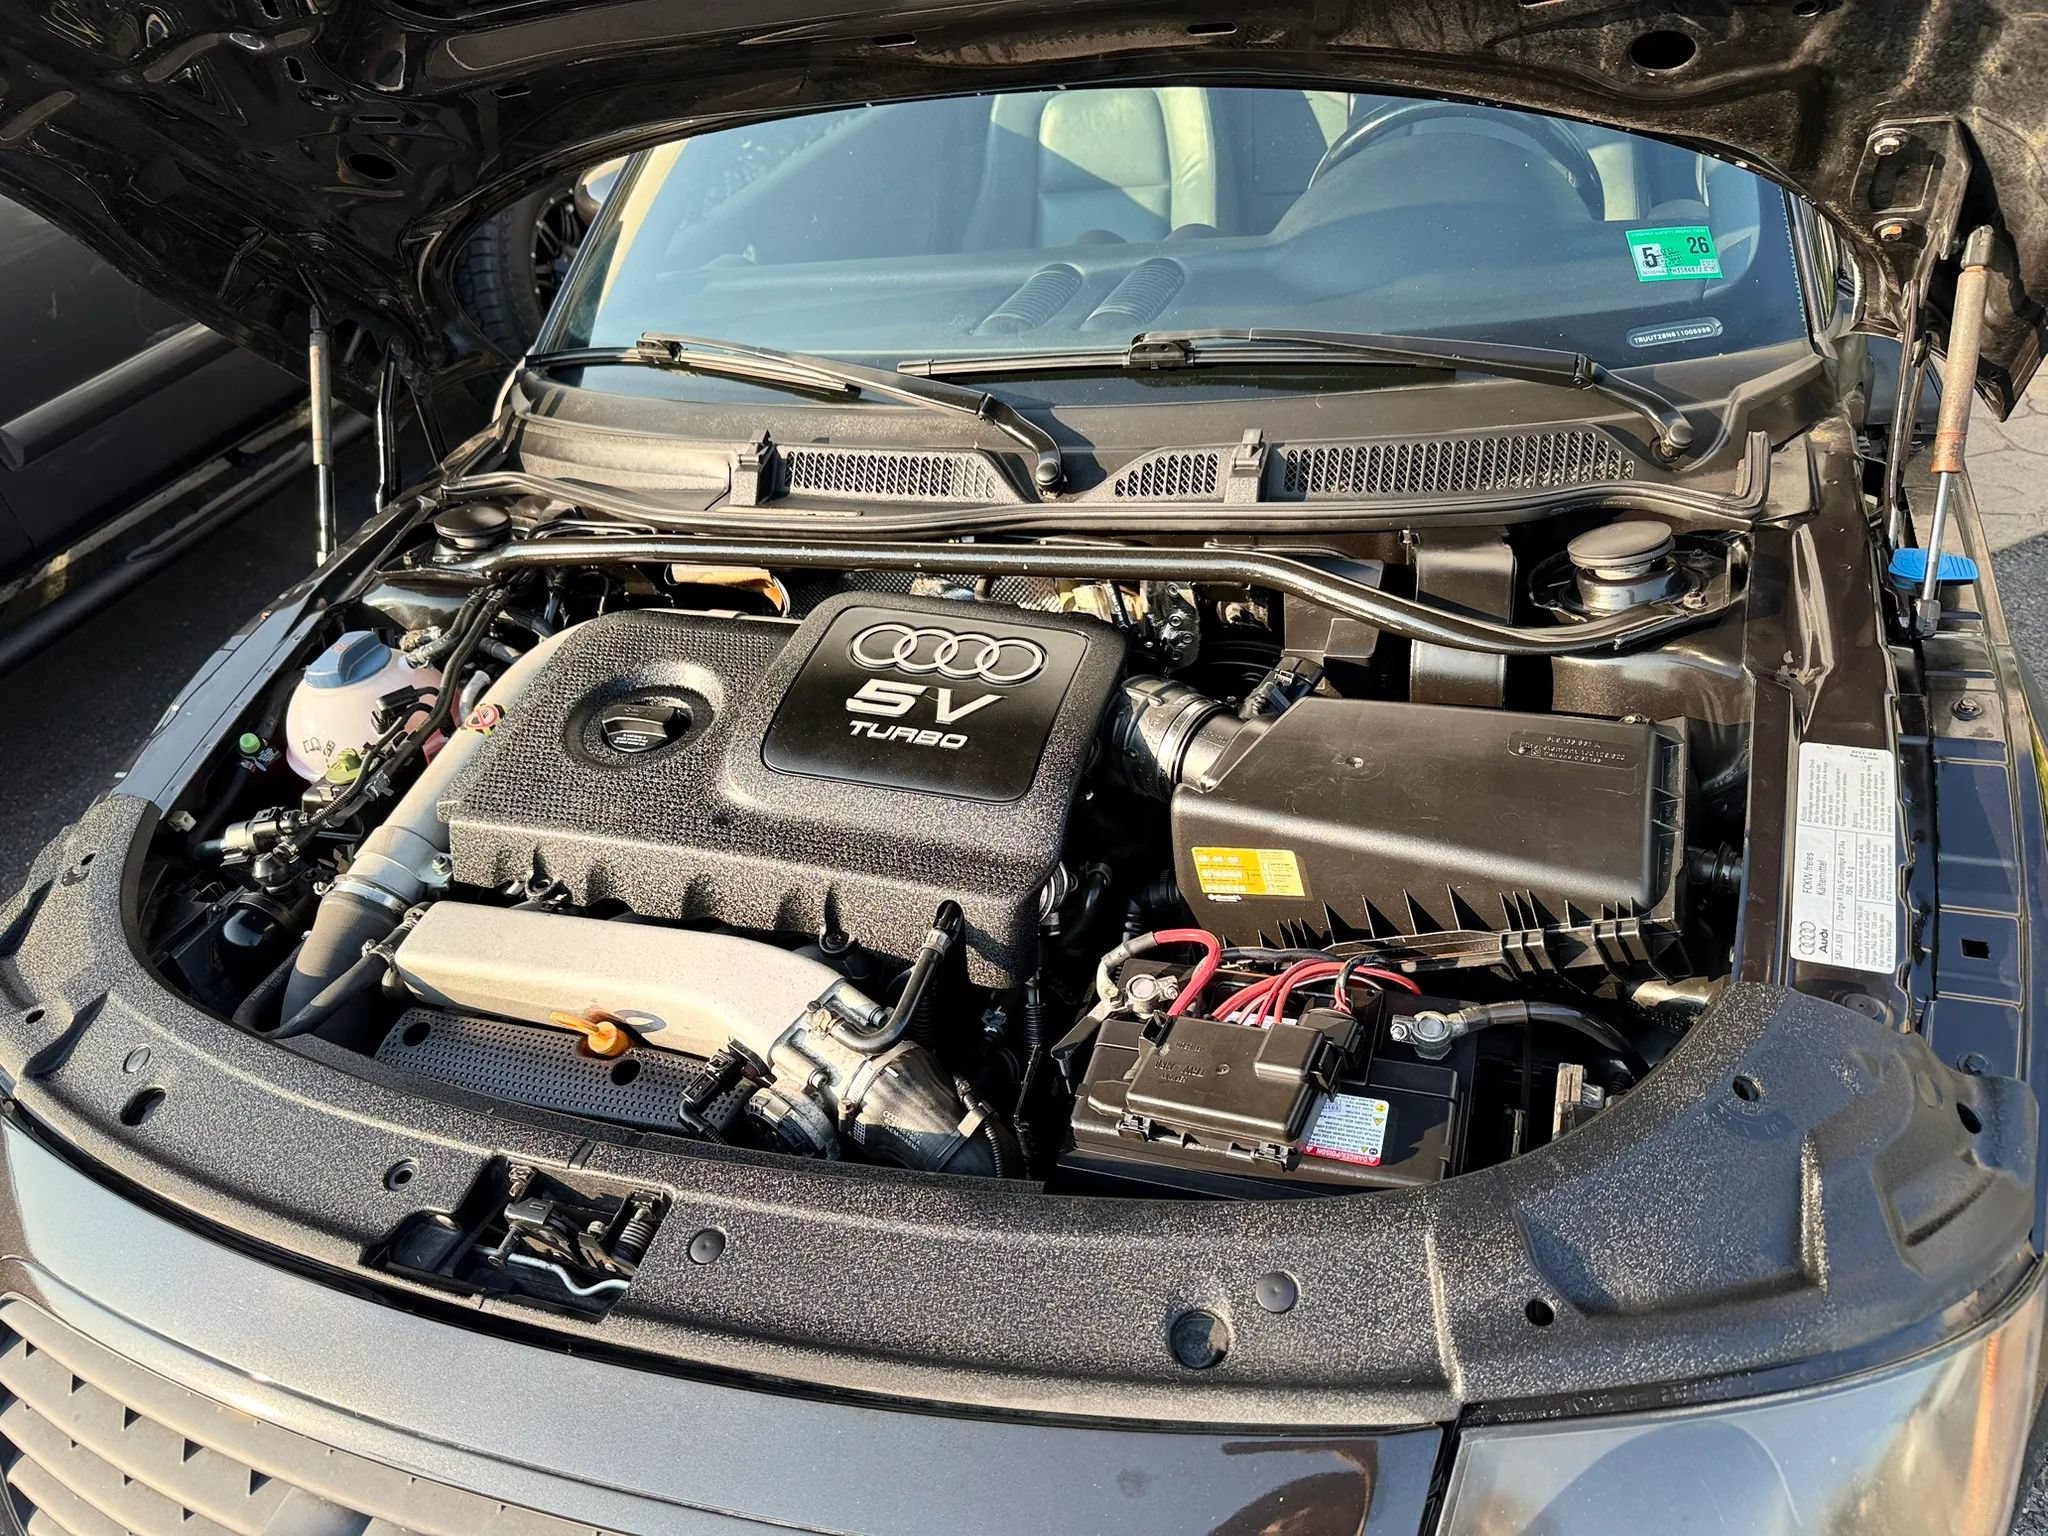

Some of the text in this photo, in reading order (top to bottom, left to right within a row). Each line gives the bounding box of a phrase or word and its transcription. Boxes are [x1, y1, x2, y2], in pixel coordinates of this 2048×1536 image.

[1686, 236, 1710, 253] 26
[1642, 247, 1658, 268] 5
[845, 679, 1006, 724] 5V
[849, 720, 968, 749] TURBO
[1803, 852, 1814, 894] FCKW-freies
[1836, 902, 1845, 920] Charge
[1819, 928, 1828, 954] Audi
[1316, 1148, 1367, 1163] DANGER/POISON
